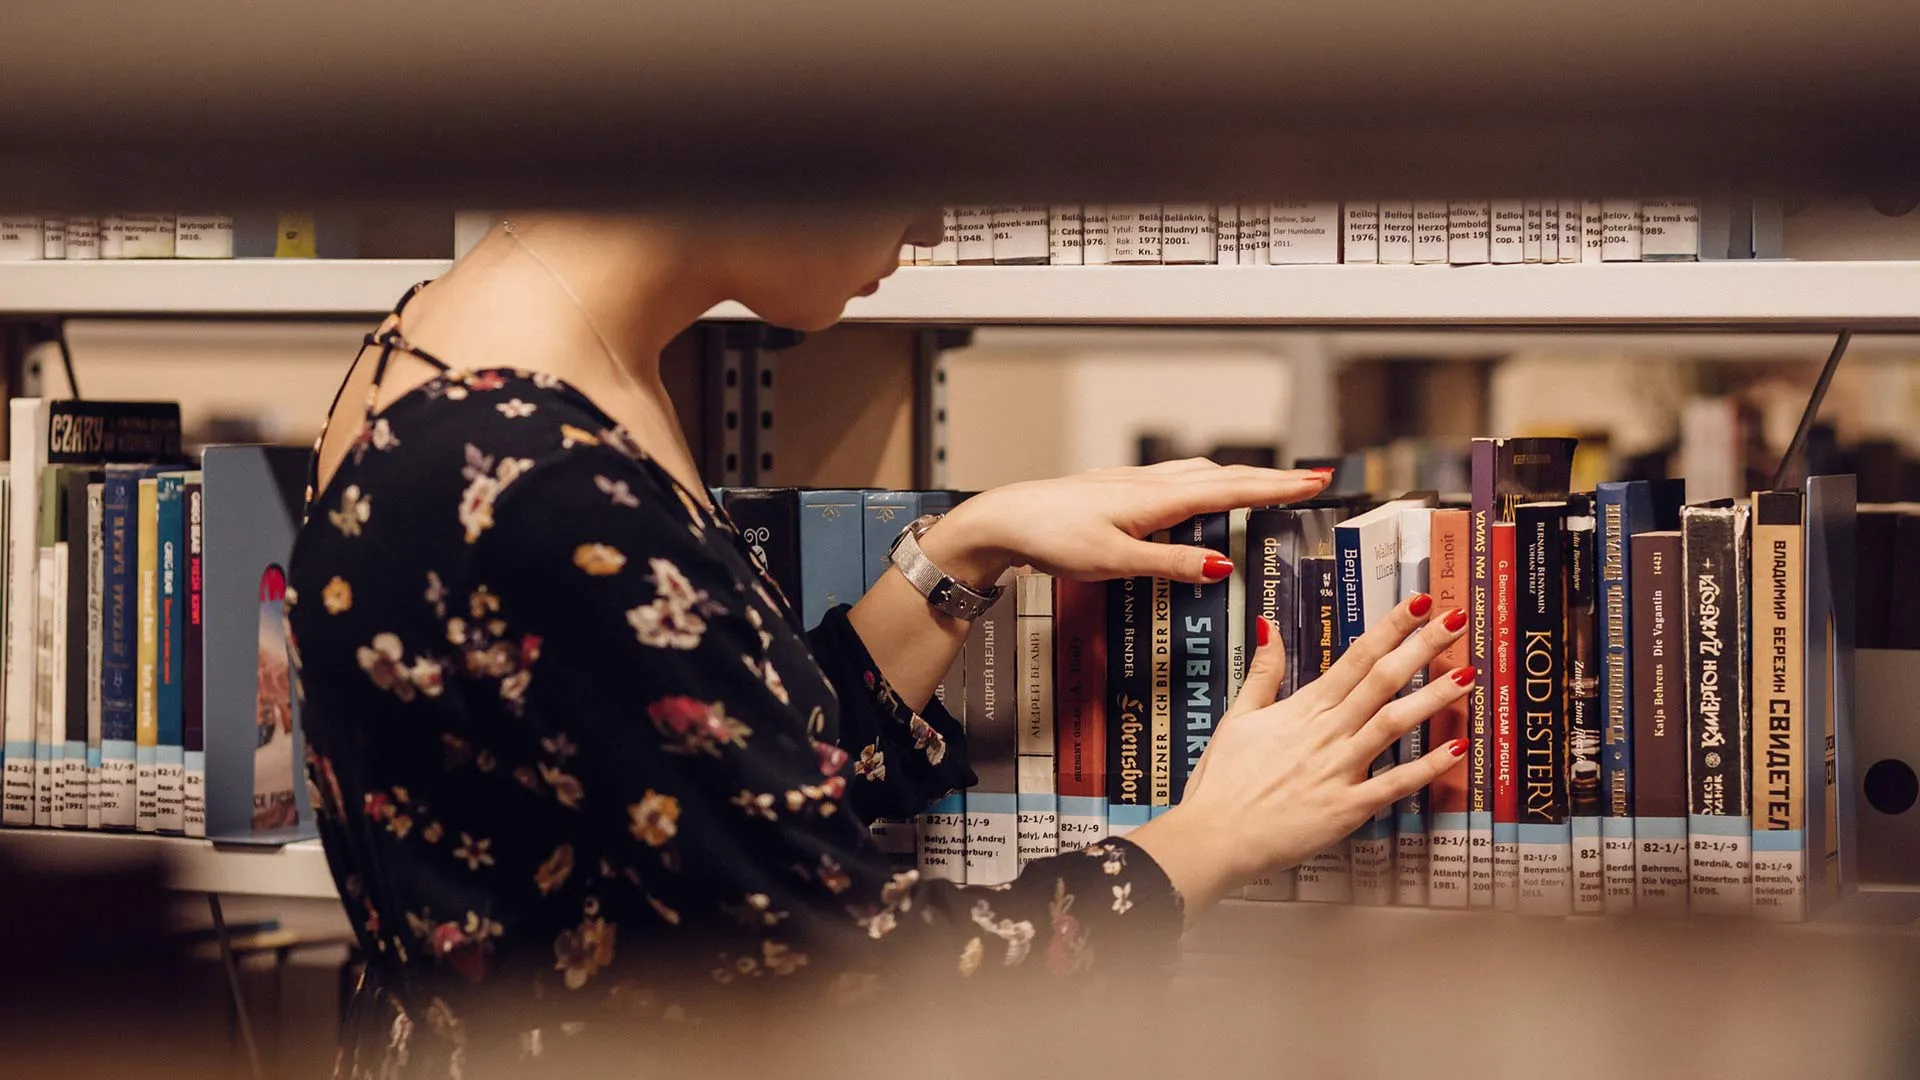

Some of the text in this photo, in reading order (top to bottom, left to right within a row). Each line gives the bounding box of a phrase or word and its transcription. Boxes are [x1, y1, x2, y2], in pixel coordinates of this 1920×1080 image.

[1449, 208, 1479, 217] ellow,
[994, 232, 1012, 240] 961.
[1351, 234, 1377, 242] 1976.
[1384, 235, 1411, 243] 1976.
[1450, 231, 1470, 241] post
[1495, 236, 1515, 244] cop.
[1603, 236, 1629, 244] 2004.
[1474, 511, 1486, 552] ŚWIATA
[1573, 530, 1582, 547] idia
[1263, 538, 1280, 575] david
[1440, 533, 1455, 600] P. Benoit
[1475, 556, 1485, 579] PAN
[1499, 560, 1509, 570] G.
[1528, 543, 1537, 595] YOHAN PEREZ
[1536, 521, 1547, 613] BERNARD BENYAMIN
[1343, 549, 1359, 622] Benjamin
[1496, 574, 1510, 624] Benusiglio,
[1124, 594, 1134, 623] ANN
[1155, 578, 1167, 621] KÖNI
[1475, 585, 1485, 658] ANTYCHRYST
[1499, 627, 1509, 636] R.
[1124, 628, 1135, 678] BENDER
[1156, 628, 1167, 655] DER
[1320, 606, 1331, 673] iften Band VI
[1652, 551, 1664, 737] Katja Behrens Die Vagantin 14421
[1233, 645, 1243, 680] GŁĘBIA
[1497, 639, 1509, 673] Agasso
[983, 620, 995, 720] АНДРЕЙ БЕЛЫЙ
[1156, 661, 1167, 688] BIN
[1573, 660, 1585, 697] Zawód:
[1029, 633, 1040, 739] АНДРЕЙ БЕЛЫЙ
[1185, 616, 1212, 777] SUBMAR
[1767, 540, 1790, 831] ВЛАДИМИР БЕРЕЗИН СВИДЕТЕЛ
[1157, 694, 1167, 716] ICH
[1475, 686, 1485, 734] BENSON
[1498, 685, 1510, 735] WZIĘŁAM
[1574, 700, 1586, 724] żona
[1525, 630, 1554, 821] KOD ESTERY
[1117, 692, 1143, 805] Lebensbor
[1156, 733, 1167, 798] BELZNER
[1475, 742, 1485, 784] HUGON
[977, 835, 1007, 845] Andrej
[1061, 823, 1099, 833] 82-1/-9
[1061, 840, 1083, 850] Belyj,
[1433, 854, 1466, 863] Benoit,
[1523, 853, 1557, 862] 82-1/-9
[1694, 841, 1738, 852] 82-1/-9
[924, 858, 948, 866] 1994.
[1641, 864, 1683, 873] Behrens,
[1693, 859, 1733, 868] Berdnik,
[1755, 862, 1793, 872] 82-1/-9
[1433, 881, 1459, 890] 1981.
[1641, 876, 1658, 885] Die
[1692, 873, 1740, 883] Kamerton
[1754, 875, 1793, 884] Berezin,
